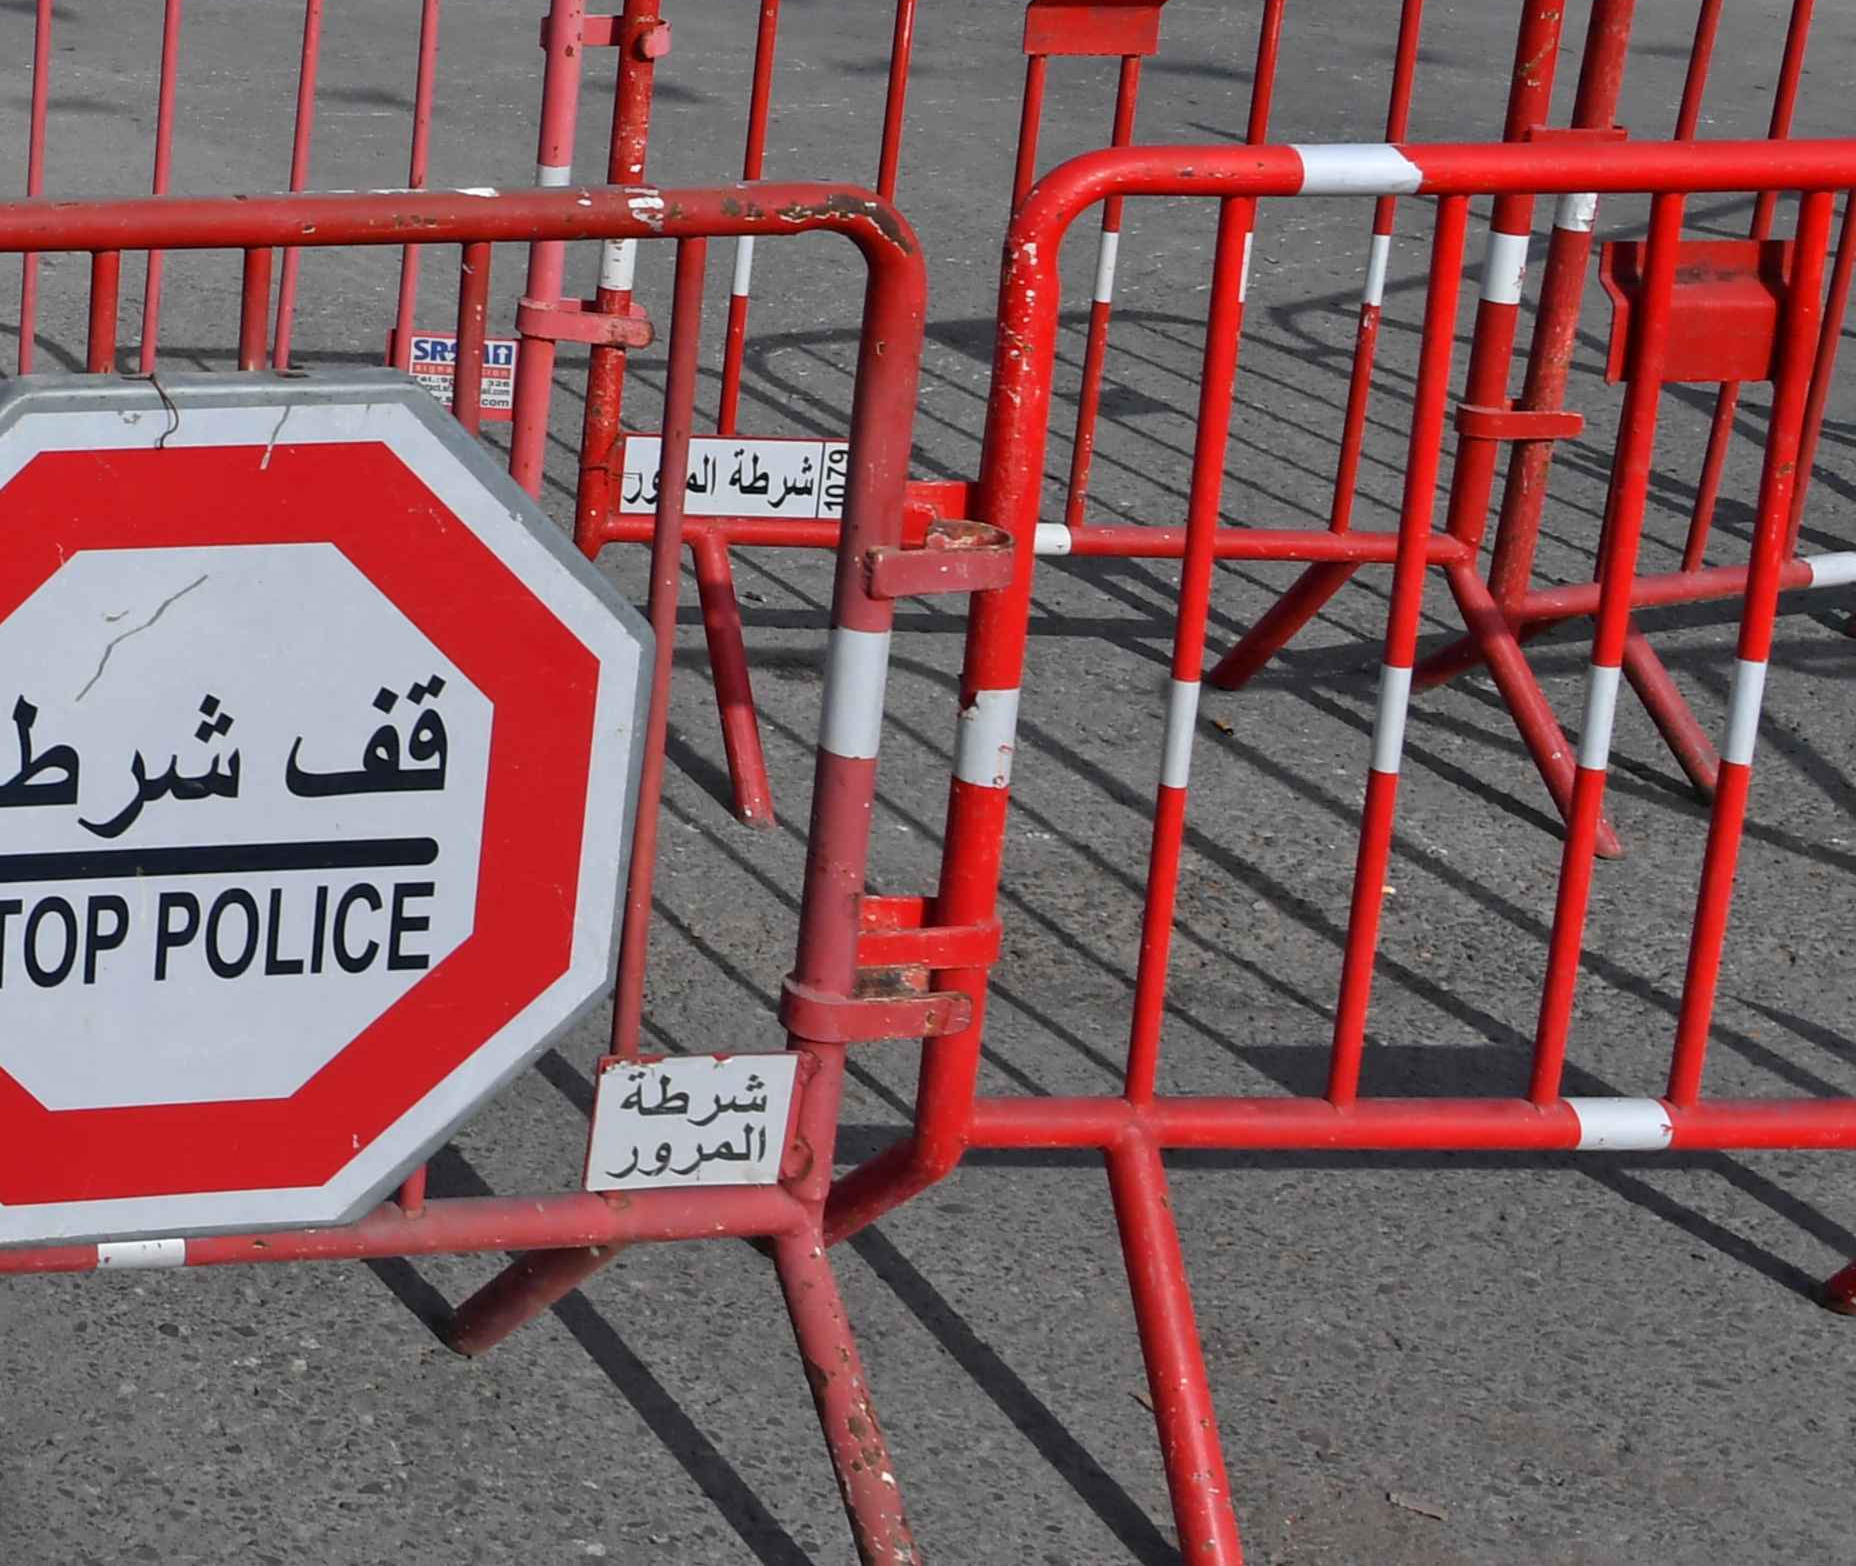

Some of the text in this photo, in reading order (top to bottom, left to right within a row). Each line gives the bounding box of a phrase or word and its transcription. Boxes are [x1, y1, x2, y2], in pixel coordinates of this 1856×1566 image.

[728, 448, 814, 509] شرطة
[824, 449, 850, 512] 1079
[285, 673, 449, 800] قف
[153, 880, 437, 983] POLICE
[619, 1071, 768, 1127] شرطة
[605, 1122, 767, 1179] المرور
